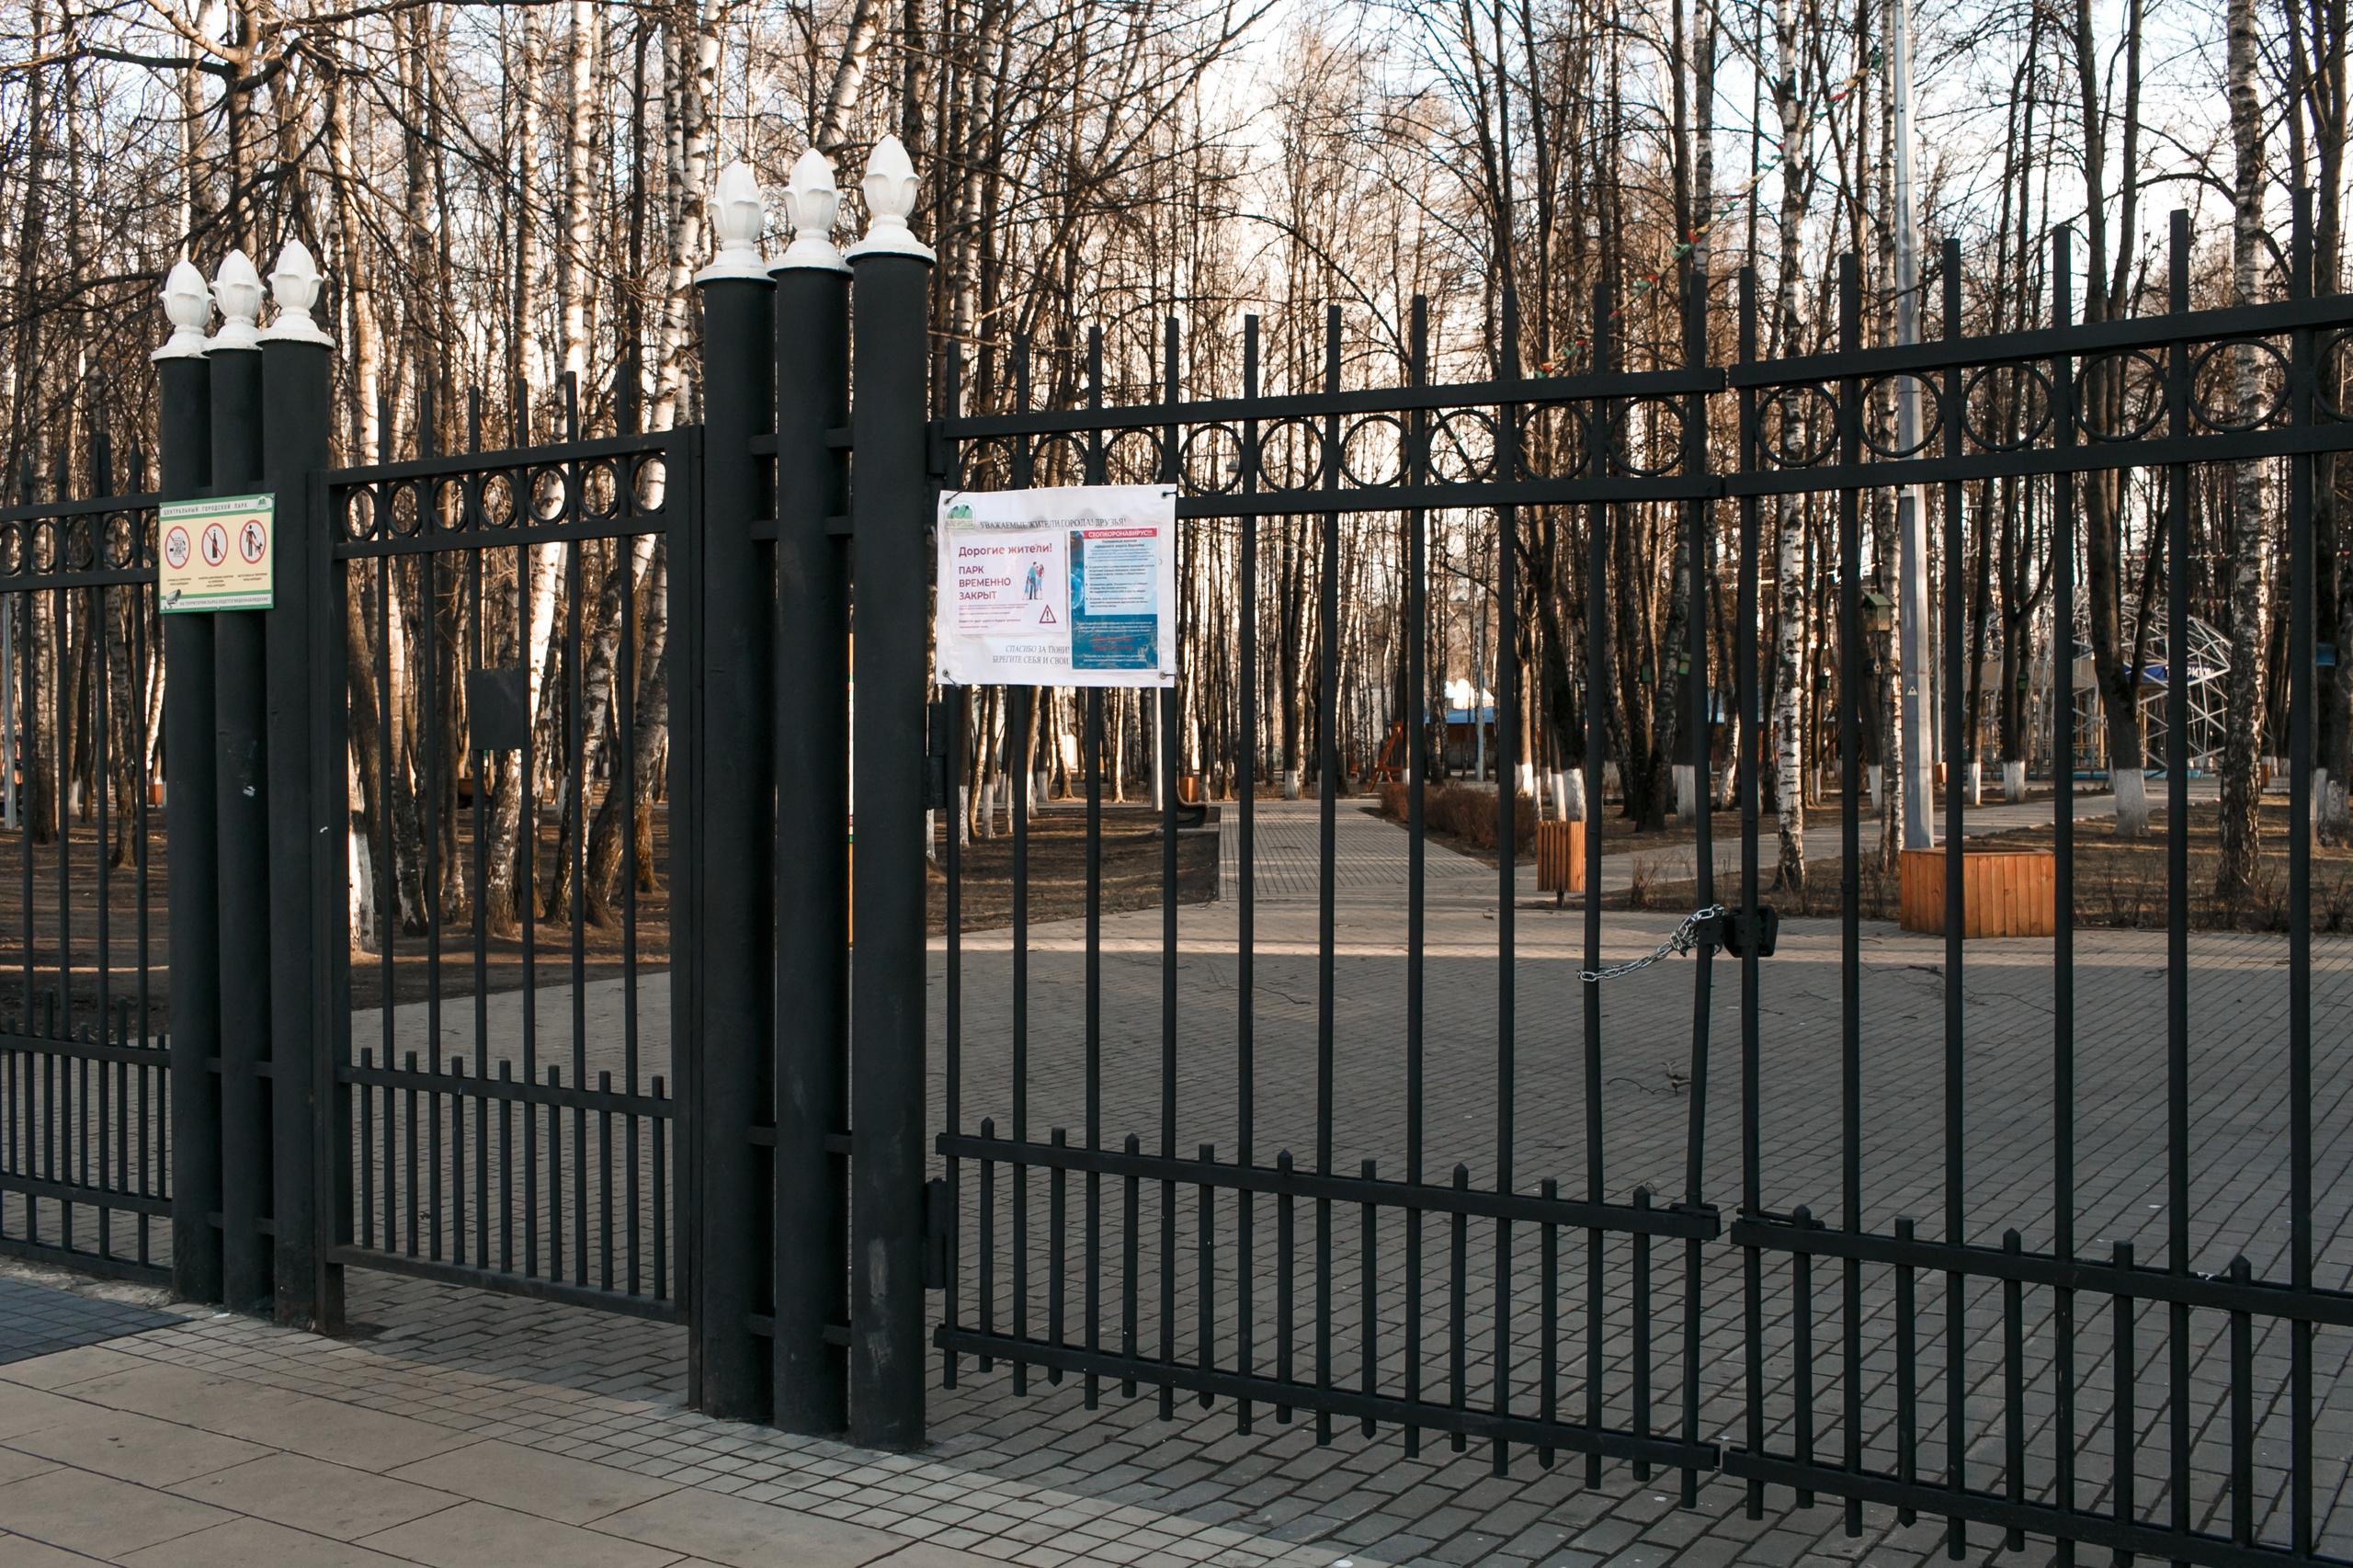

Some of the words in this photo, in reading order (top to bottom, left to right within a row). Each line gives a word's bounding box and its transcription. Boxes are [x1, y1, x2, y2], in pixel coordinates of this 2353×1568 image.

[164, 506, 199, 516] ЦЕНТРАЛЬНЫЙ
[202, 503, 231, 511] ГОРОДСКОЙ
[980, 521, 1028, 529] УВАЖАЕМЫЕ
[1029, 519, 1060, 528] ЖИТЕЛИ
[1062, 518, 1094, 528] ГОРОДА!
[1096, 517, 1127, 527] ДРУЗЬЯ!
[959, 546, 1005, 558] Дорогие
[1008, 543, 1052, 554] жители!
[959, 565, 984, 574] ПАРК
[959, 577, 1011, 587] ВРЕМЕННО
[959, 591, 997, 600] ЗАКРЫТ
